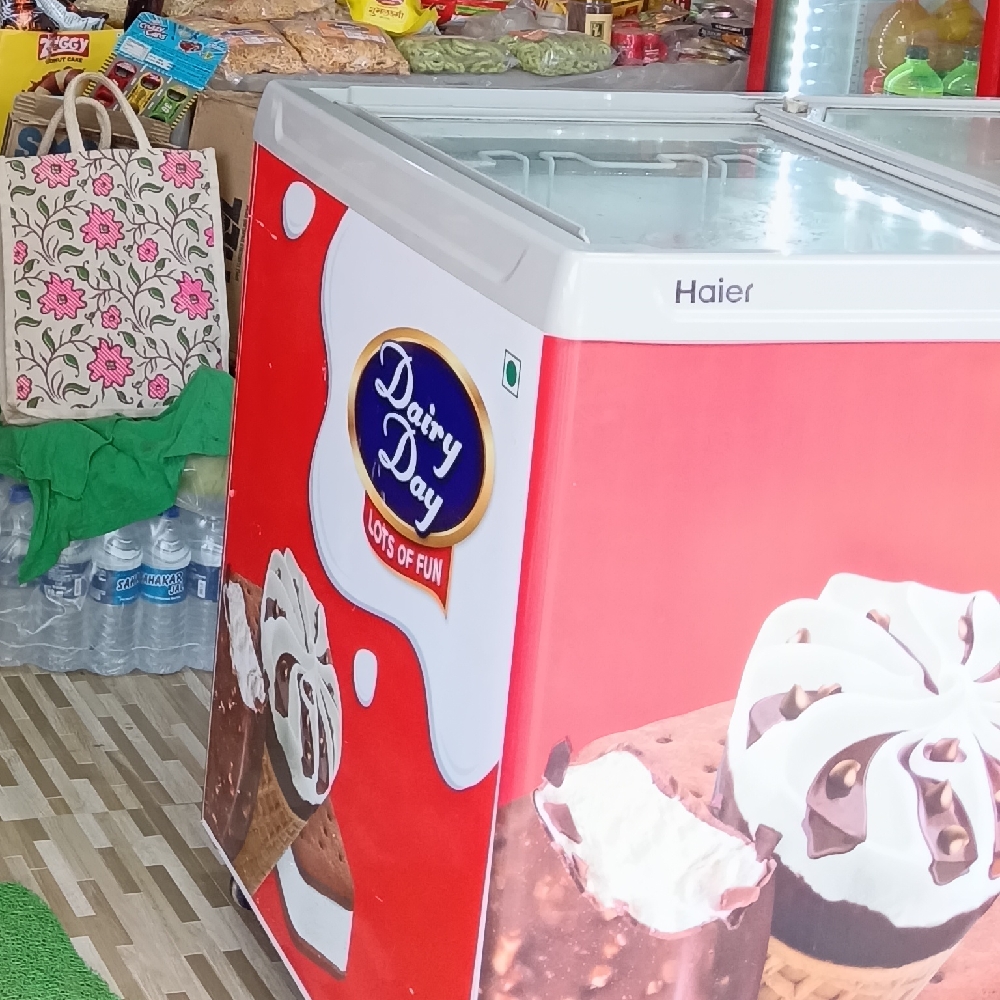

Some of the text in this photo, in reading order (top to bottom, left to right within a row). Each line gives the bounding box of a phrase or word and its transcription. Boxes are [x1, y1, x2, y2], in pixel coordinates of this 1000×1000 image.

[675, 278, 755, 304] Haier
[373, 339, 463, 478] Dairy
[376, 411, 445, 533] Day
[367, 508, 445, 587] LOTS OF FUN
